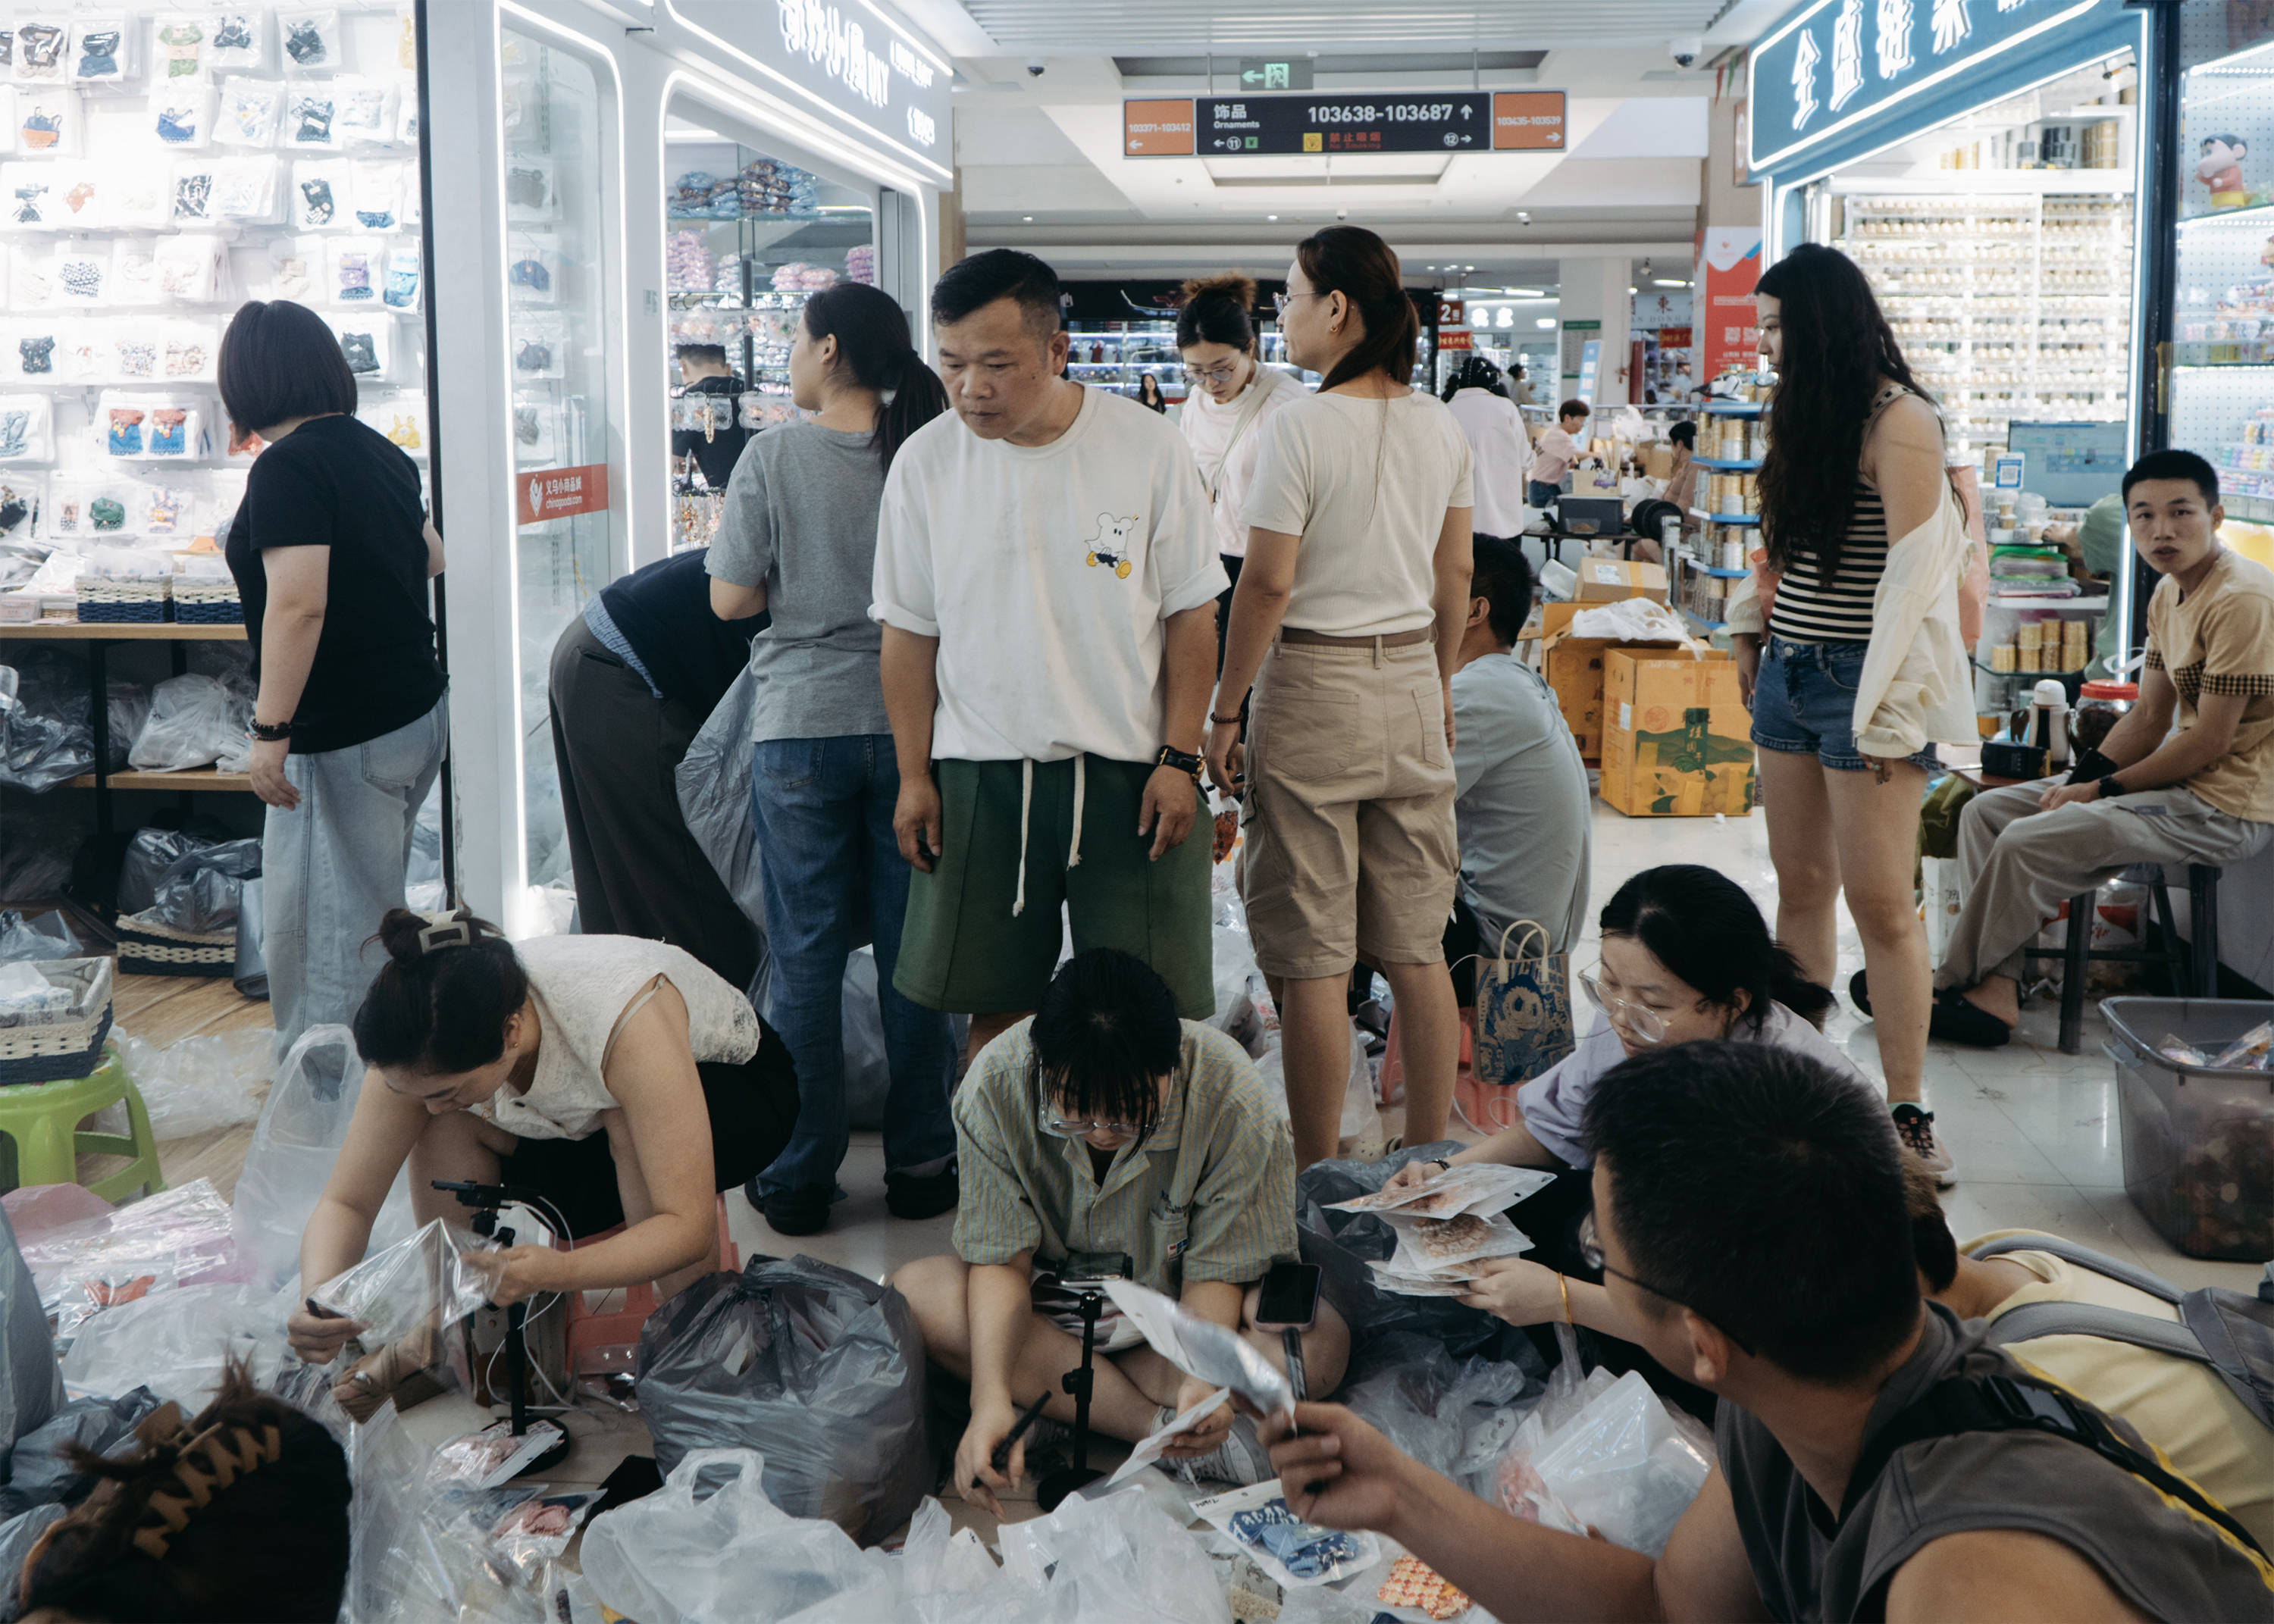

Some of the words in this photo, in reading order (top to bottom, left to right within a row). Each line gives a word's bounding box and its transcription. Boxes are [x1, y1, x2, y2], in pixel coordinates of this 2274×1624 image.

[1213, 104, 1247, 120] 饰品
[1308, 104, 1454, 124] 103638-103687
[1128, 123, 1192, 133] 103371-103412
[1213, 120, 1260, 130] Ornaments
[546, 475, 582, 495] 义乌小商品城
[546, 496, 582, 510] chinagoods.com
